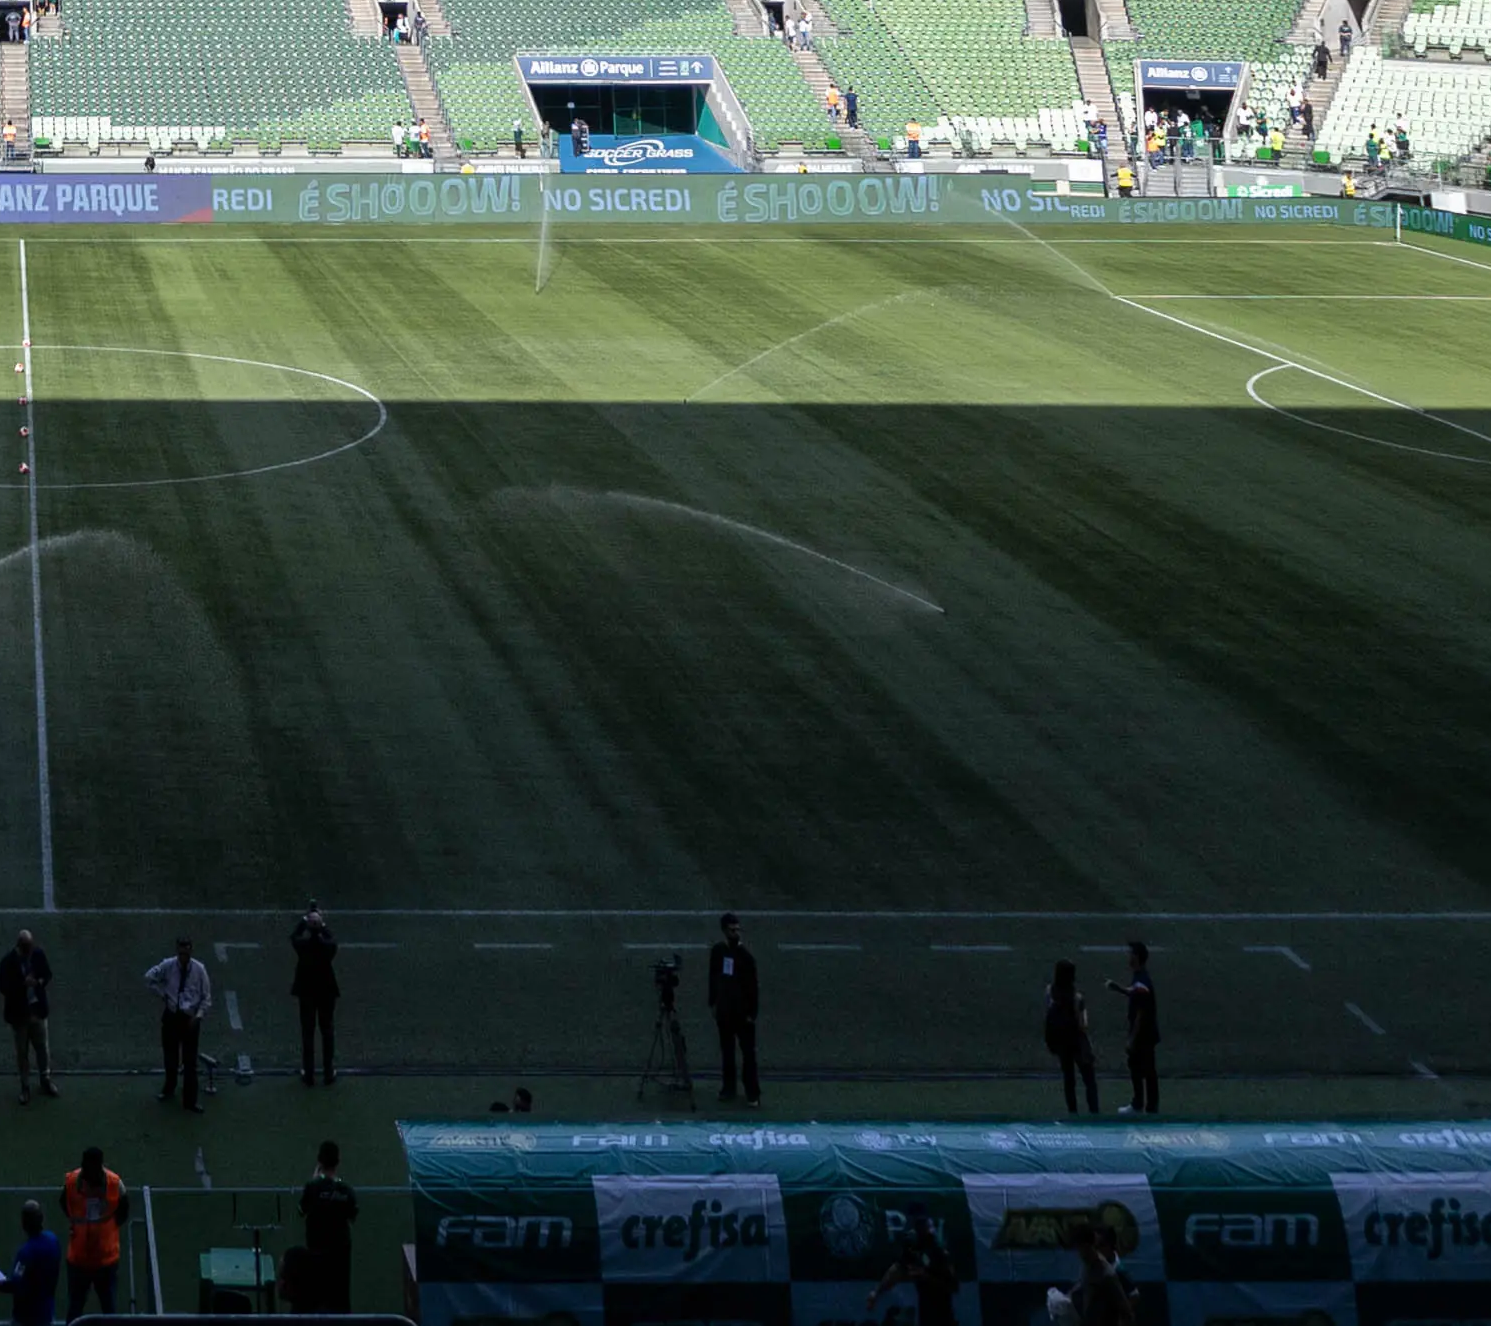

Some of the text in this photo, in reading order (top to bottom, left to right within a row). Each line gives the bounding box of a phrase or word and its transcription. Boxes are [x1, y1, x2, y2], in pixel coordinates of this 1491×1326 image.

[529, 60, 644, 77] Allianz Parque
[1147, 66, 1190, 79] Allianz
[583, 148, 694, 159] SOCCER GRASS
[56, 183, 159, 214] PARQUE
[212, 188, 273, 211] REDI
[1248, 183, 1294, 197] Sicredi
[544, 188, 691, 212] NO SICREDI
[981, 189, 1018, 212] NO
[1255, 205, 1339, 220] NO SICREDI
[1469, 224, 1485, 241] NO
[709, 1129, 810, 1150] crefisa
[621, 1199, 770, 1261] crefisa
